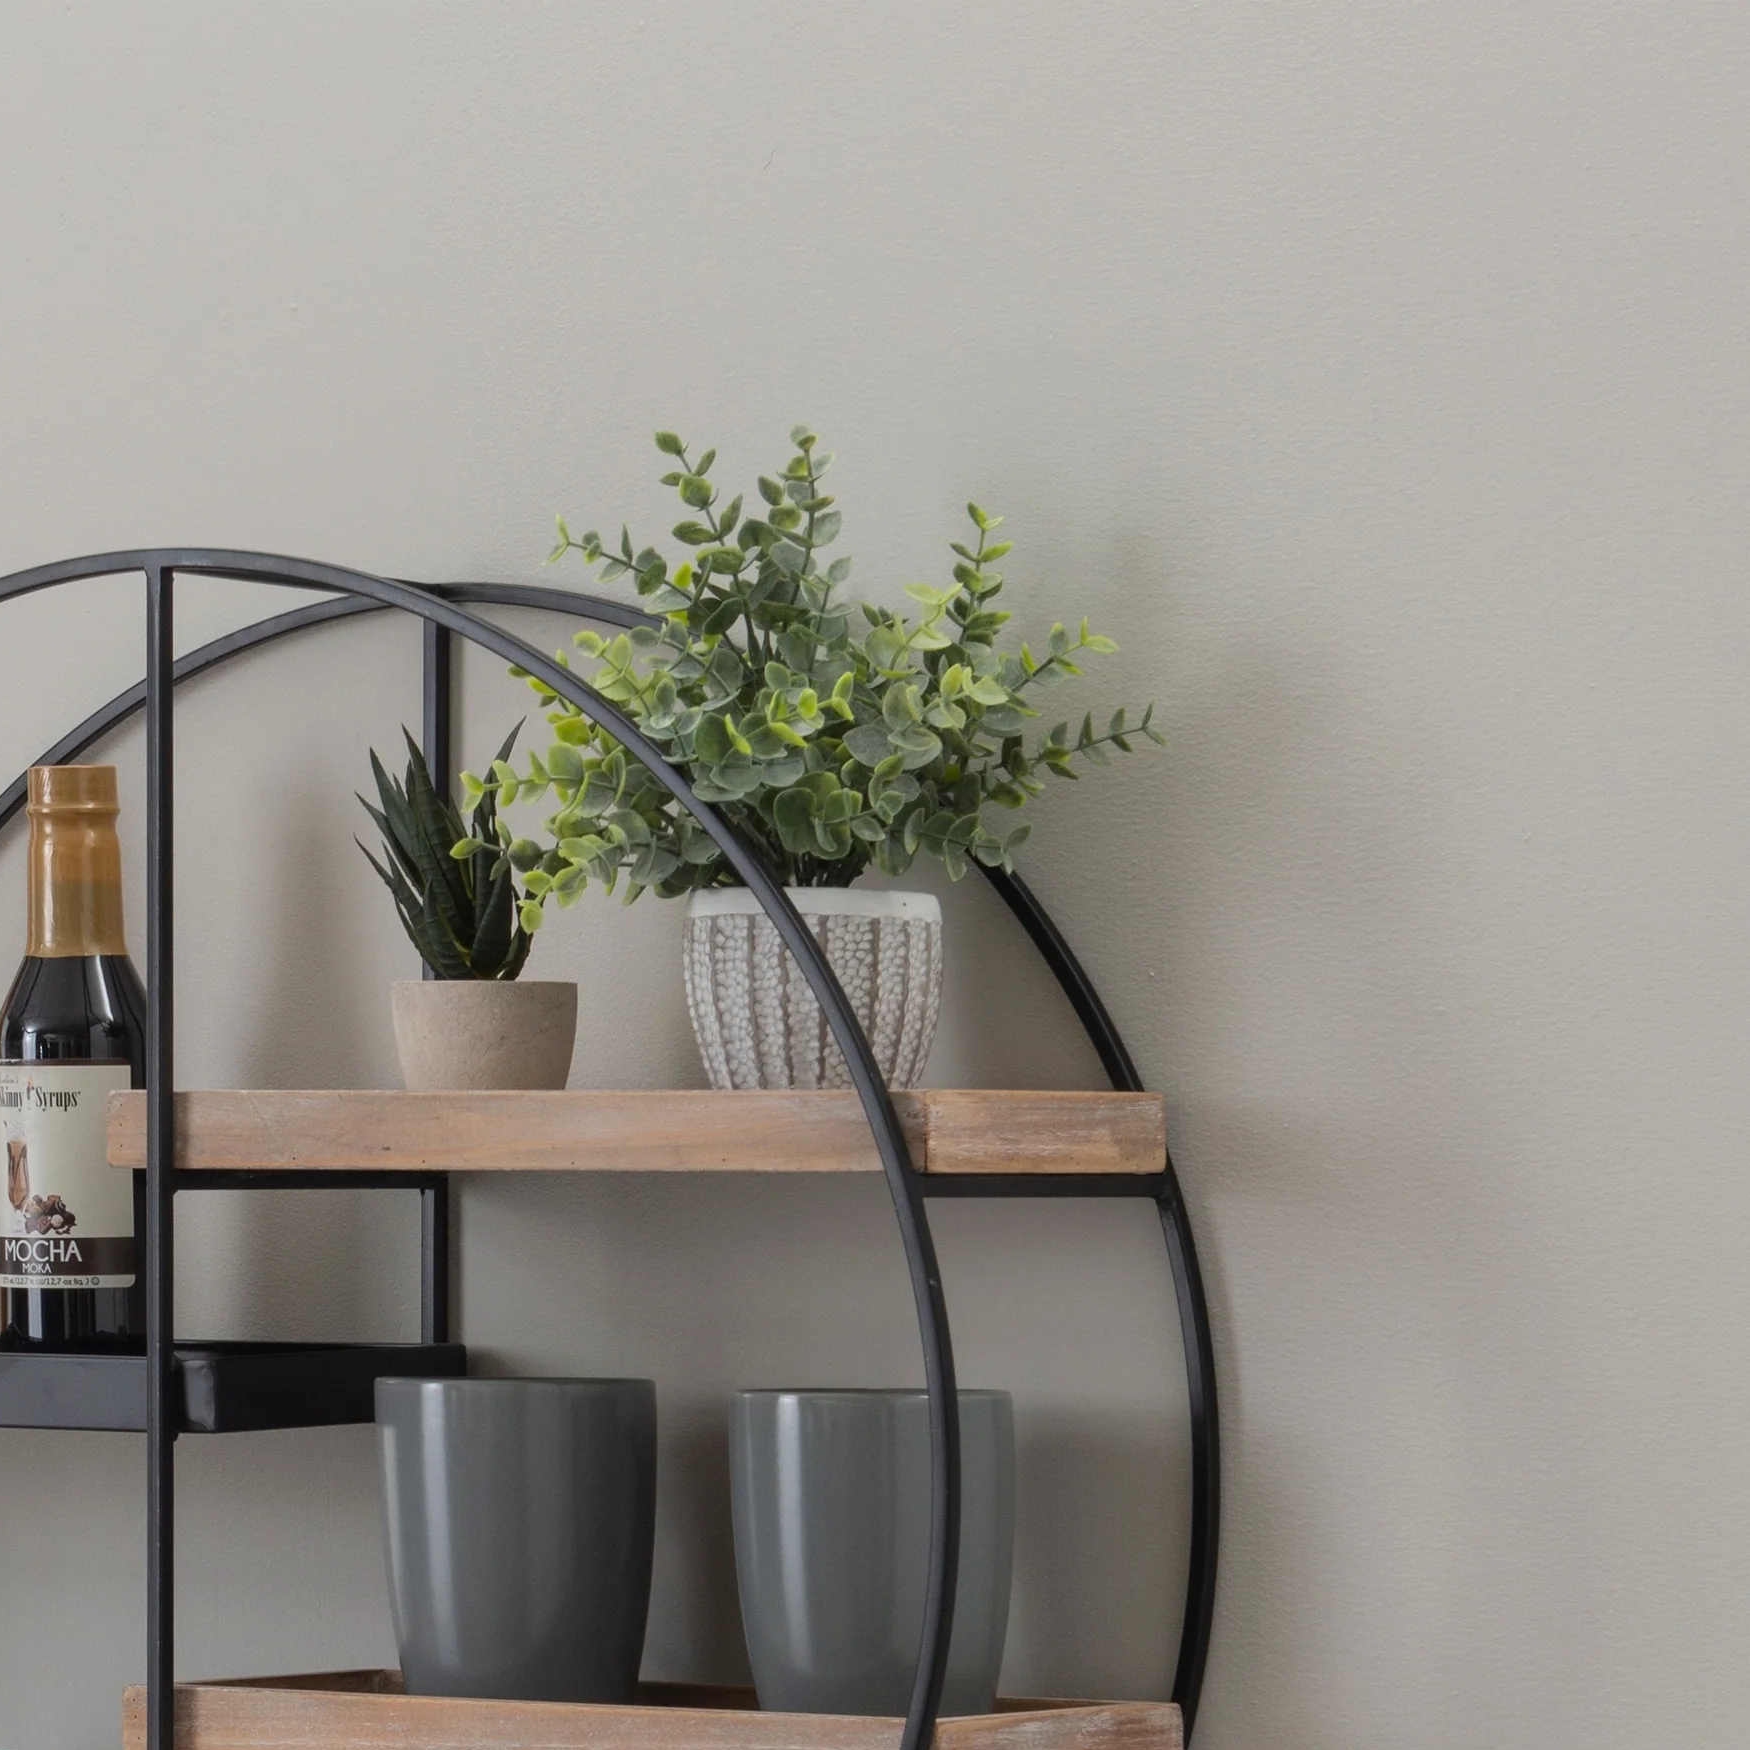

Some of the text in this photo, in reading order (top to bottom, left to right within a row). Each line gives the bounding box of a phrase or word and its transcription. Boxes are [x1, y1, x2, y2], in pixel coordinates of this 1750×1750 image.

[35, 1086, 78, 1112] Syrups
[4, 1239, 83, 1262] MOCHA
[22, 1263, 52, 1274] MOKA
